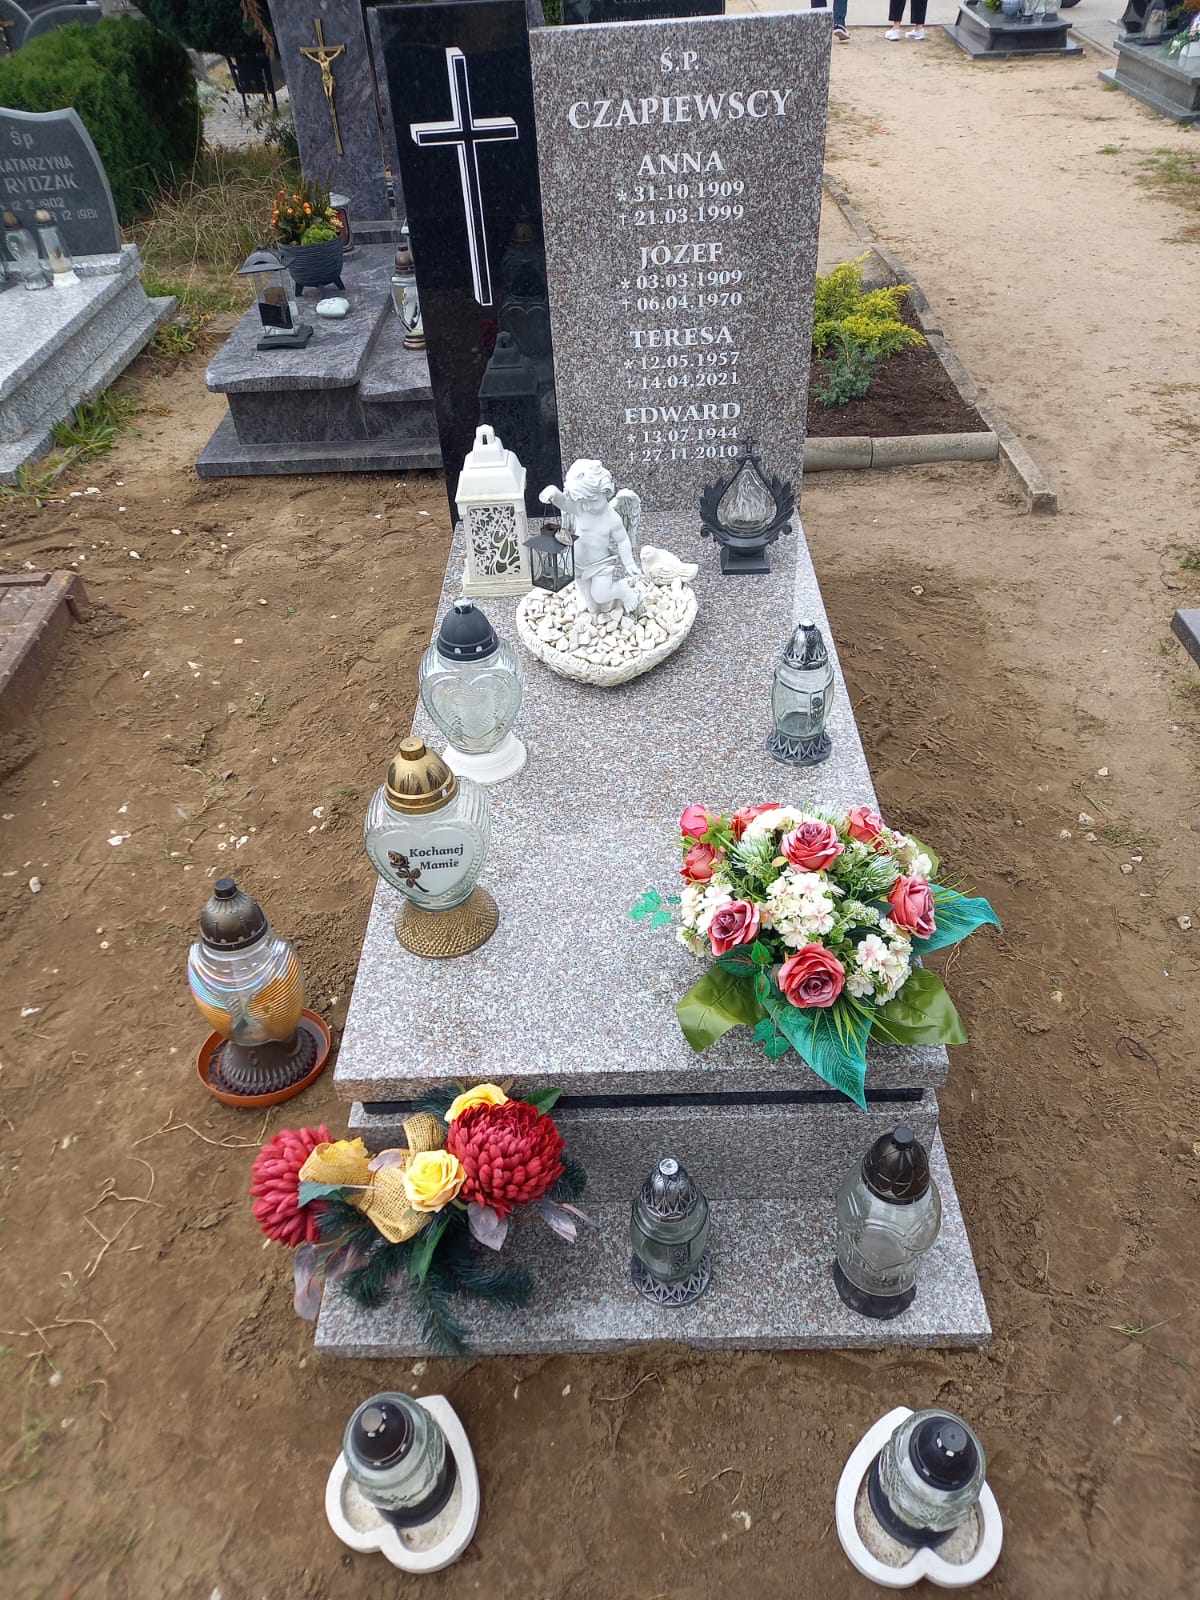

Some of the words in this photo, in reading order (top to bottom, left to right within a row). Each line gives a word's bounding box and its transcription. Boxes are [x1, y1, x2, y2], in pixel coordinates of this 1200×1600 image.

[568, 88, 794, 129] CZAPIEWSCY
[636, 150, 726, 176] ANNA
[4, 173, 79, 194] RYDZAK
[634, 180, 745, 203] 31.10.1909
[634, 204, 745, 227] 21.03.1999
[639, 239, 723, 271] JÓZEF
[636, 270, 743, 290] 03.03.1909
[637, 292, 743, 312] 06.04.1970
[630, 326, 734, 349] TERESA
[641, 352, 740, 370] 12.05.1957
[641, 371, 740, 390] 14.04.2021
[624, 402, 741, 425] EDWARD
[643, 426, 738, 444] 13.07.1944
[642, 445, 739, 462] 27.11.2010
[409, 844, 464, 858] Kochanej
[420, 859, 460, 871] Mamie
